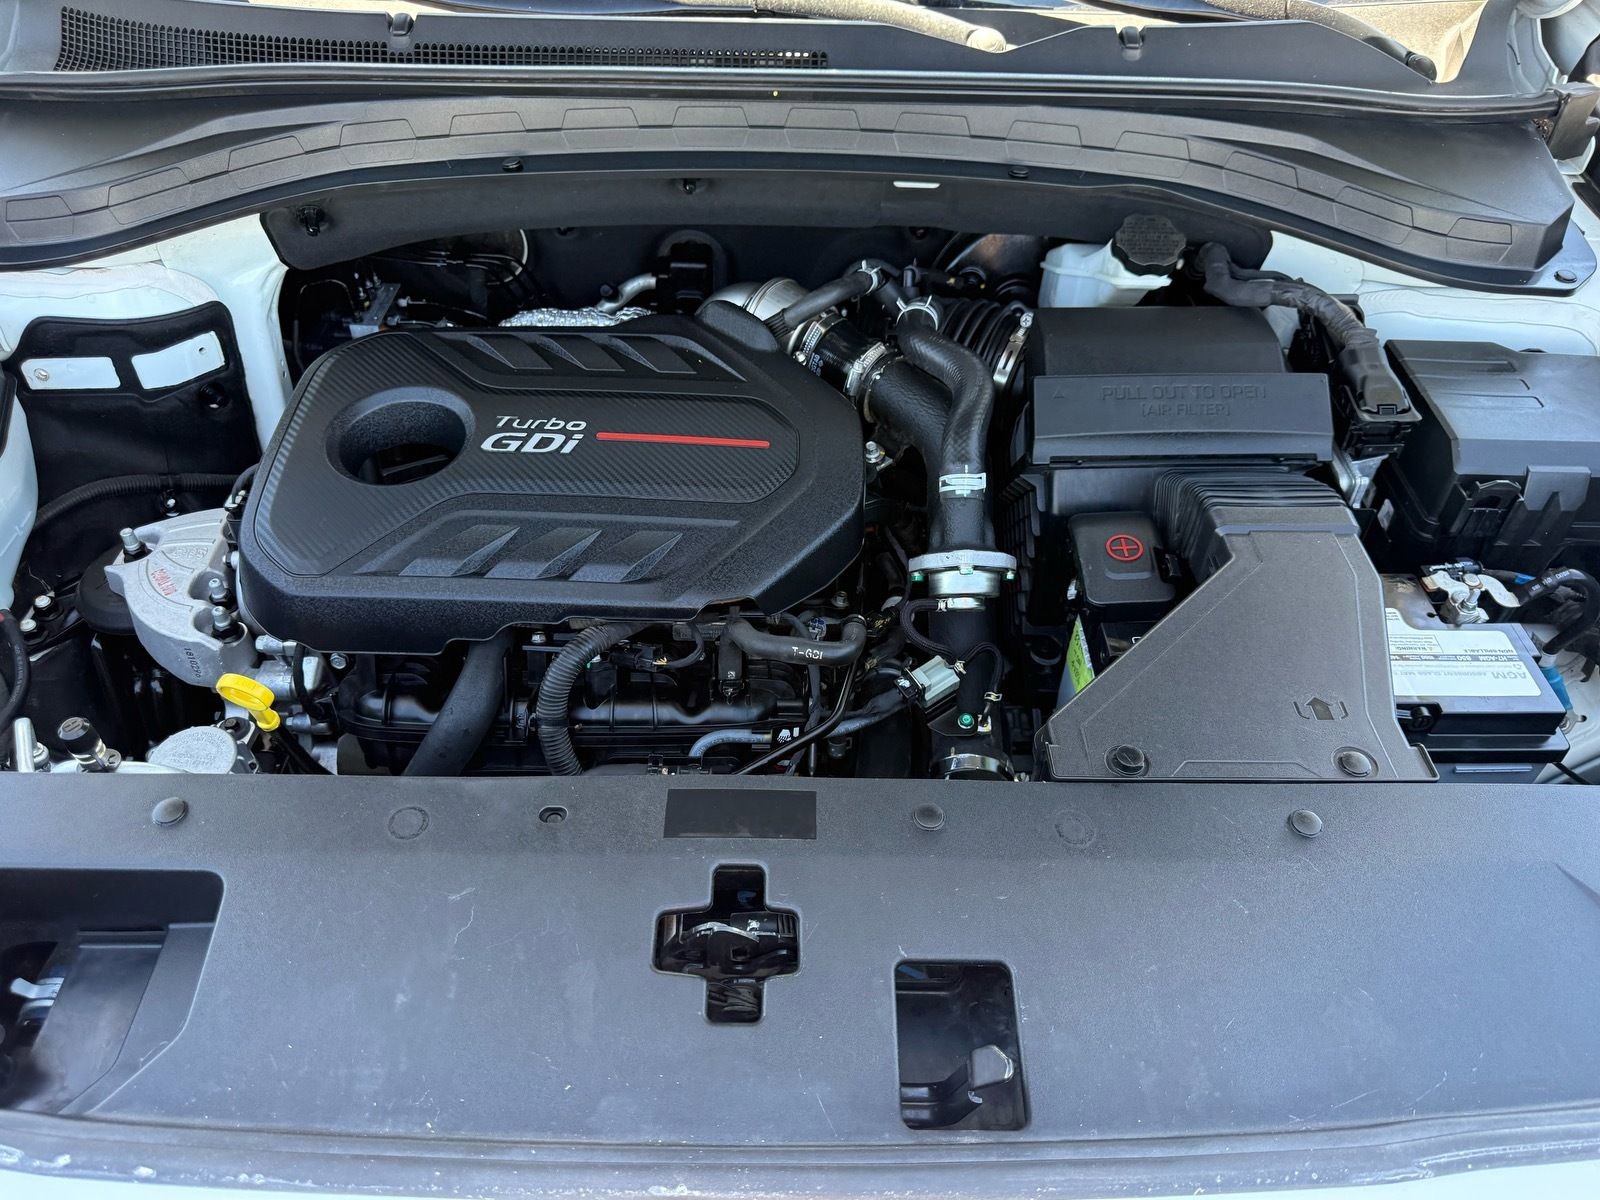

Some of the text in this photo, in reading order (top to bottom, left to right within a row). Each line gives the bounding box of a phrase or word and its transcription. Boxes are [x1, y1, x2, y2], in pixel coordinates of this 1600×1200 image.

[1101, 384, 1267, 400] PULL OUT TO OPEN
[496, 415, 587, 431] Turbo
[480, 432, 585, 454] GDi
[791, 646, 823, 659] T-GDI
[1491, 671, 1527, 680] AGM
